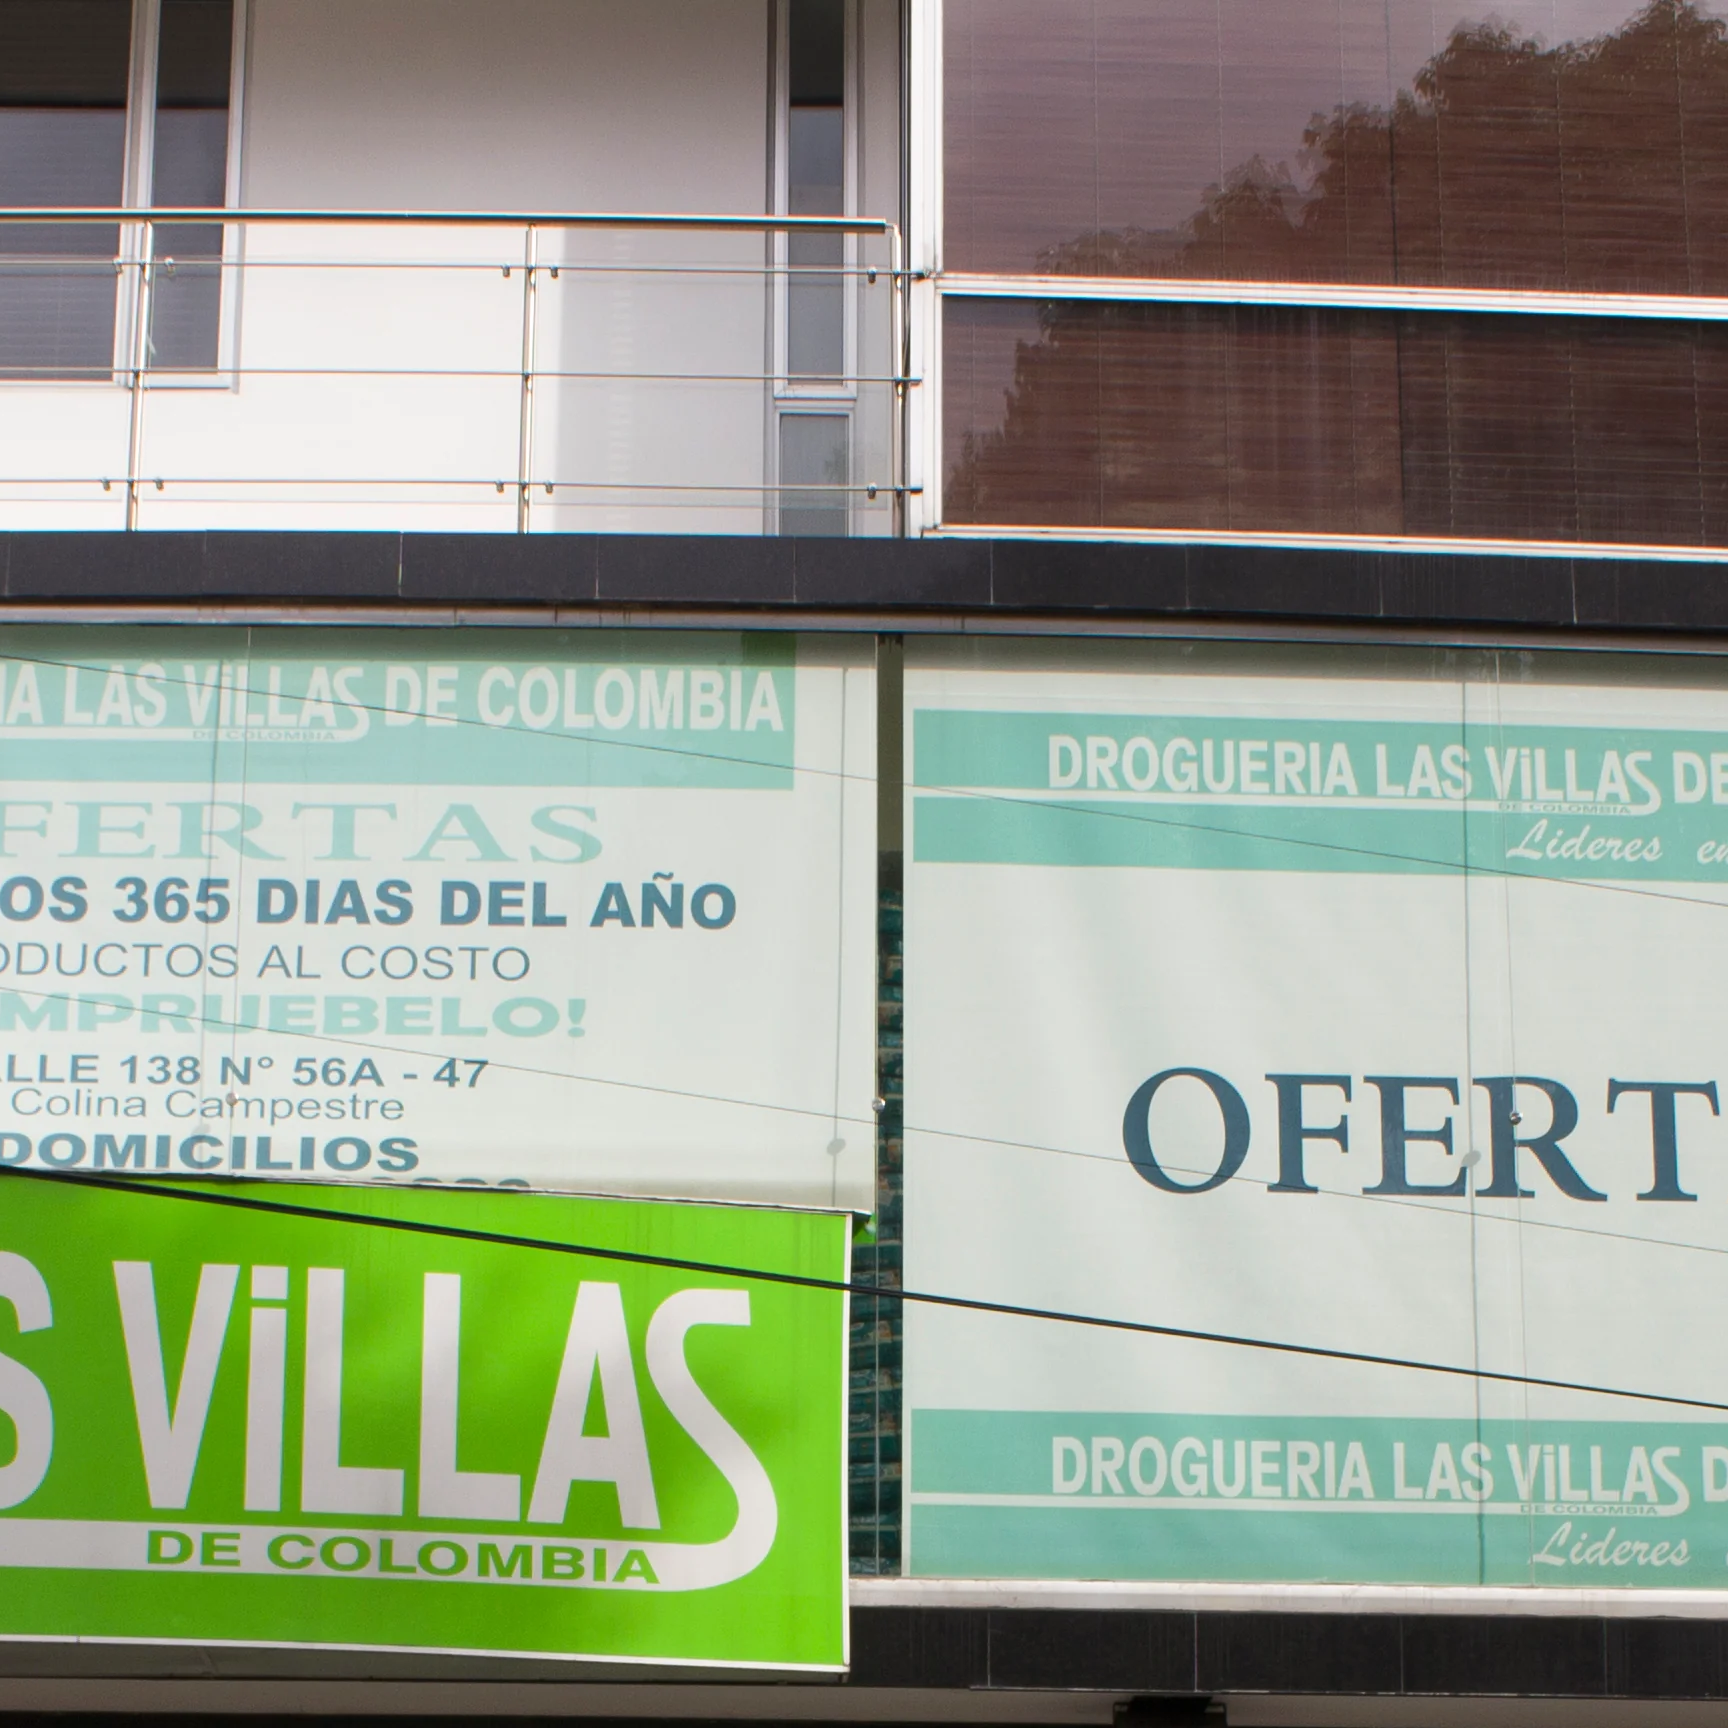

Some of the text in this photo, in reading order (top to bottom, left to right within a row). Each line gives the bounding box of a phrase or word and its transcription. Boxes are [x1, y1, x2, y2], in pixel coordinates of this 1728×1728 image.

[63, 662, 168, 729] LAS
[384, 666, 468, 731] DE
[474, 666, 785, 734] COLOMBIA
[1047, 734, 1353, 797] DROGUERIA
[1374, 742, 1472, 800] LAS
[1504, 820, 1664, 866] Lideres
[111, 875, 232, 925] 365
[254, 877, 414, 927] DIAS
[438, 879, 567, 929] DEL
[589, 872, 738, 932] AÑO
[257, 941, 323, 980] AL
[339, 941, 531, 982] COSTO
[120, 1053, 202, 1086] 138
[290, 1056, 383, 1089] 56A
[433, 1058, 490, 1090] 47
[10, 1086, 405, 1127] Colina Campestre
[1050, 1435, 1374, 1501] DROGUERIA
[1390, 1441, 1494, 1503] LAS
[146, 1529, 661, 1585] DE COLOMBIA
[1526, 1521, 1692, 1570] Lideres
